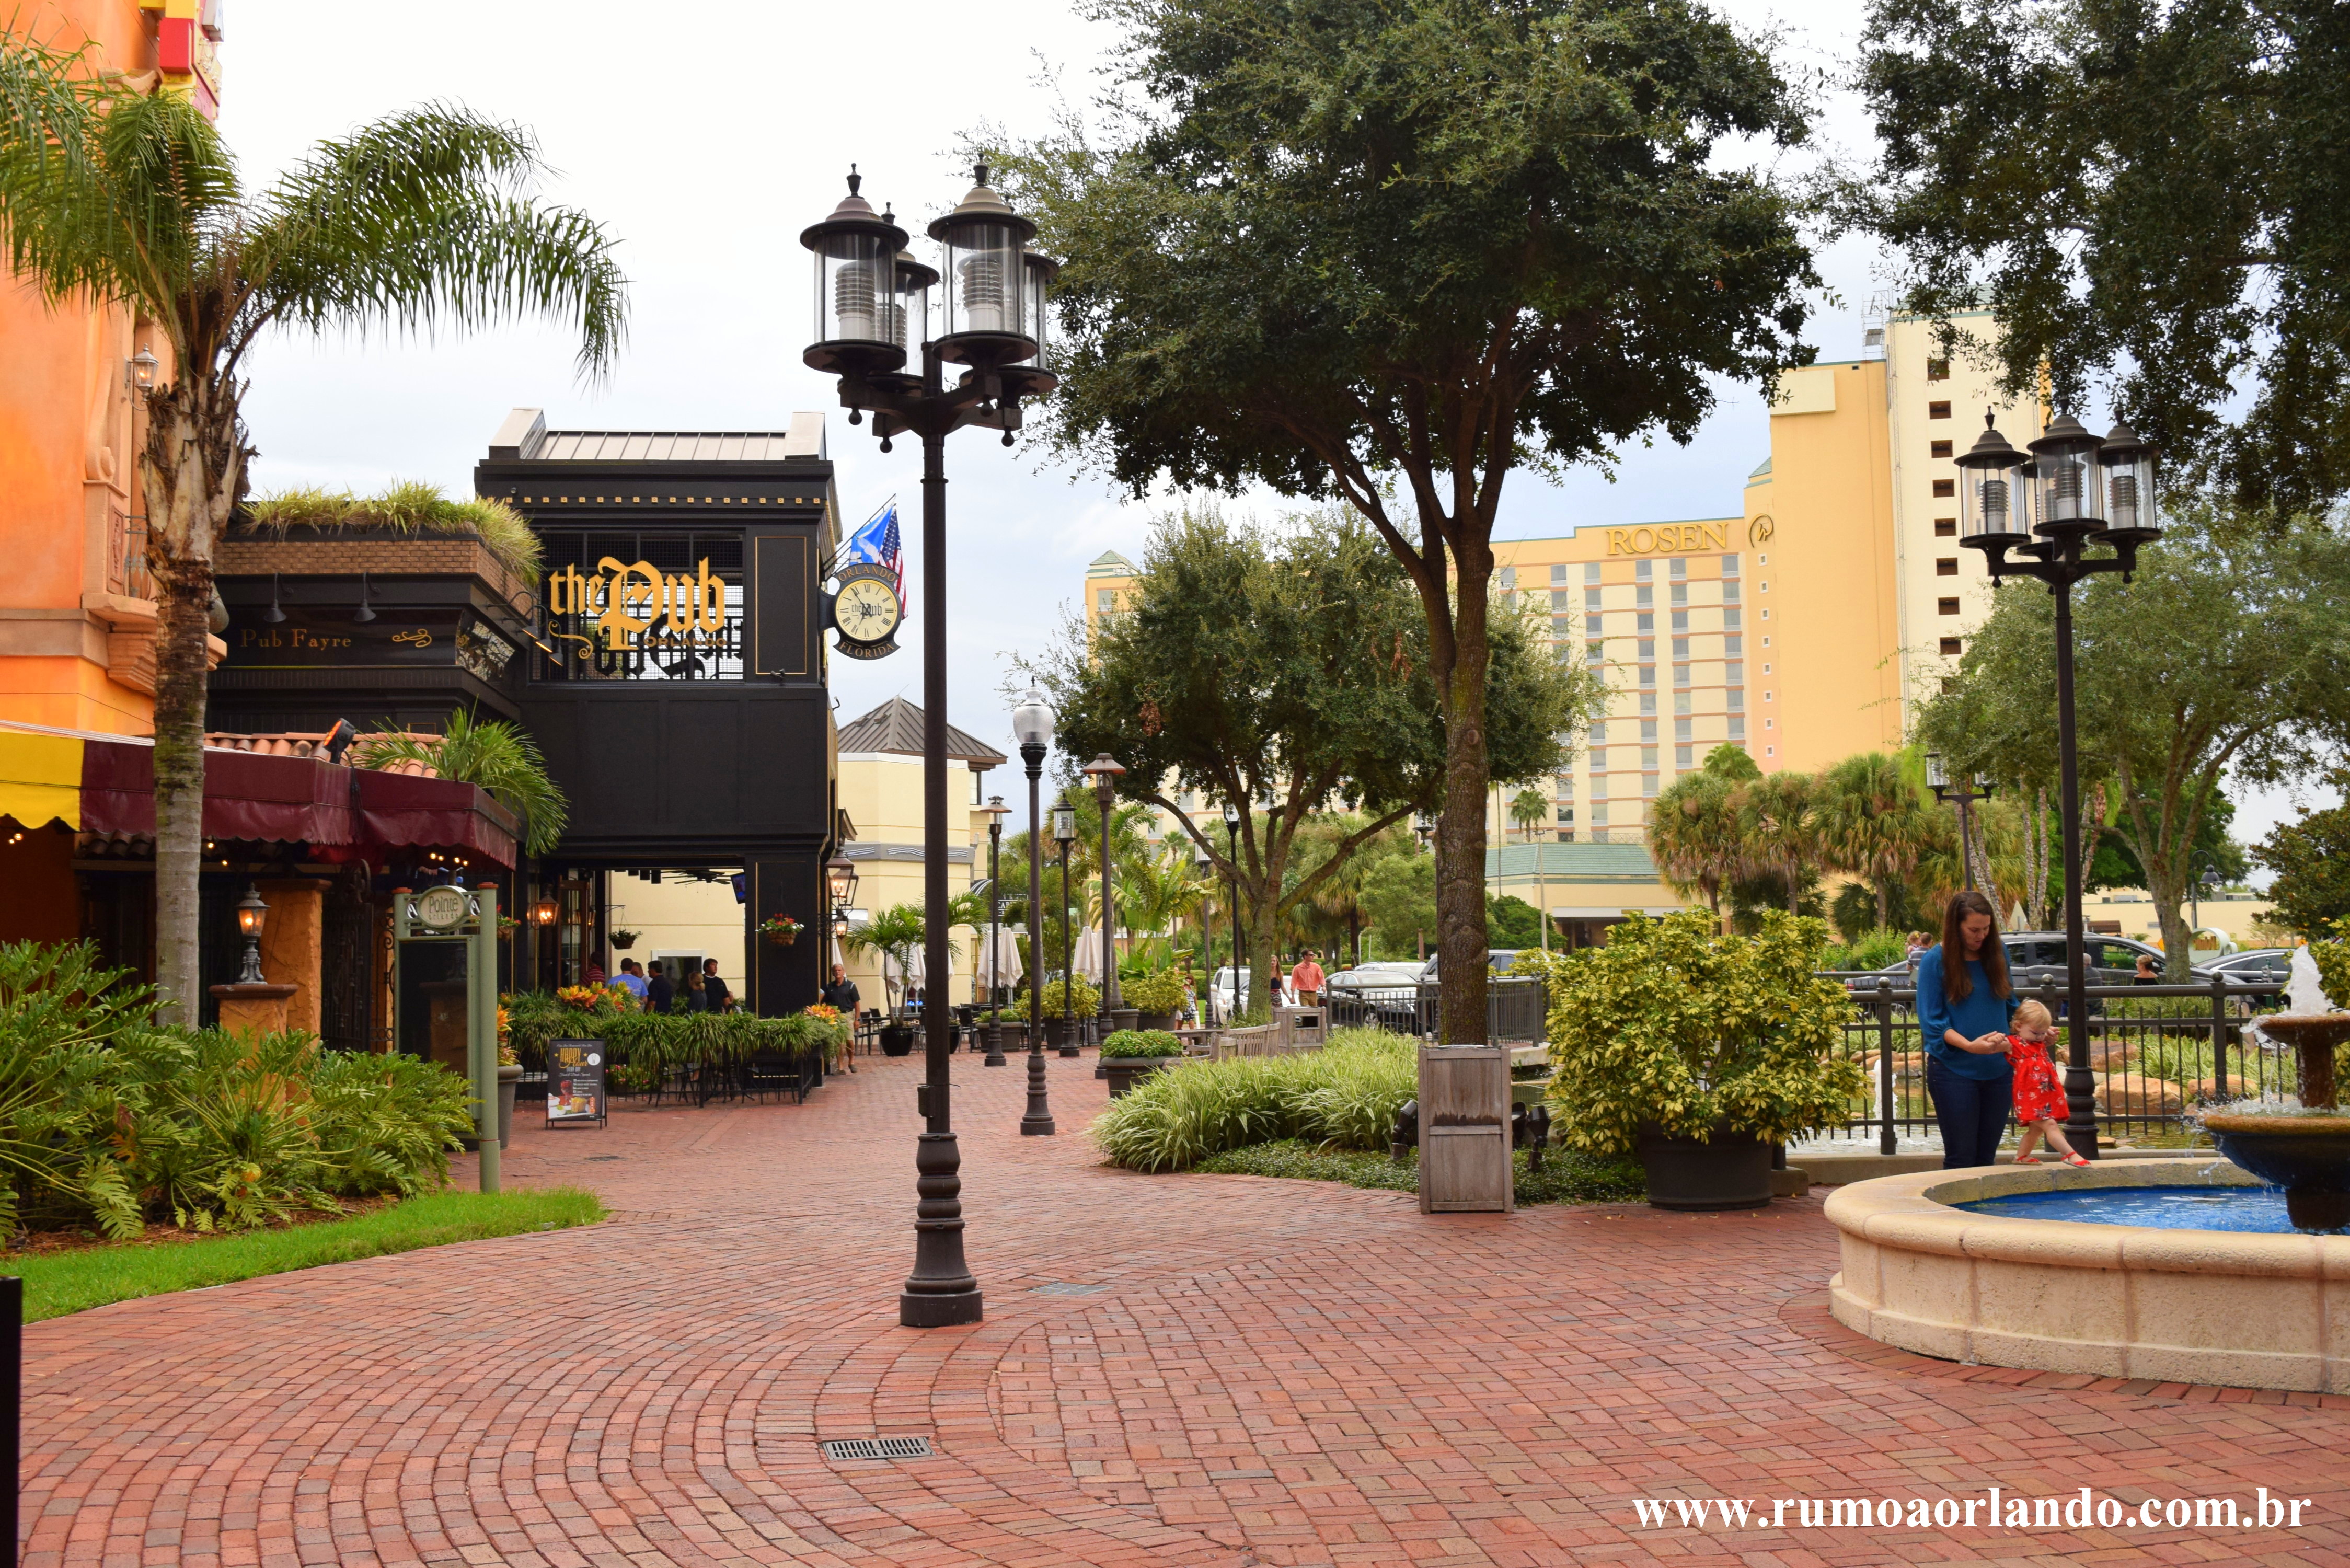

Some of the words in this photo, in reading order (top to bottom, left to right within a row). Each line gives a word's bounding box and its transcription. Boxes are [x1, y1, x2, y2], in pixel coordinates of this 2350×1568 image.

[1606, 522, 1729, 556] ROSEN
[838, 566, 896, 582] ORLANDO
[549, 563, 606, 615] the
[598, 556, 725, 650] Pub
[240, 629, 282, 647] Pub
[292, 629, 351, 651] Fayre
[643, 636, 727, 647] ORLANDO
[839, 642, 894, 658] FLORIDA
[429, 896, 458, 913] Pointe
[560, 1048, 581, 1063] HAPPY
